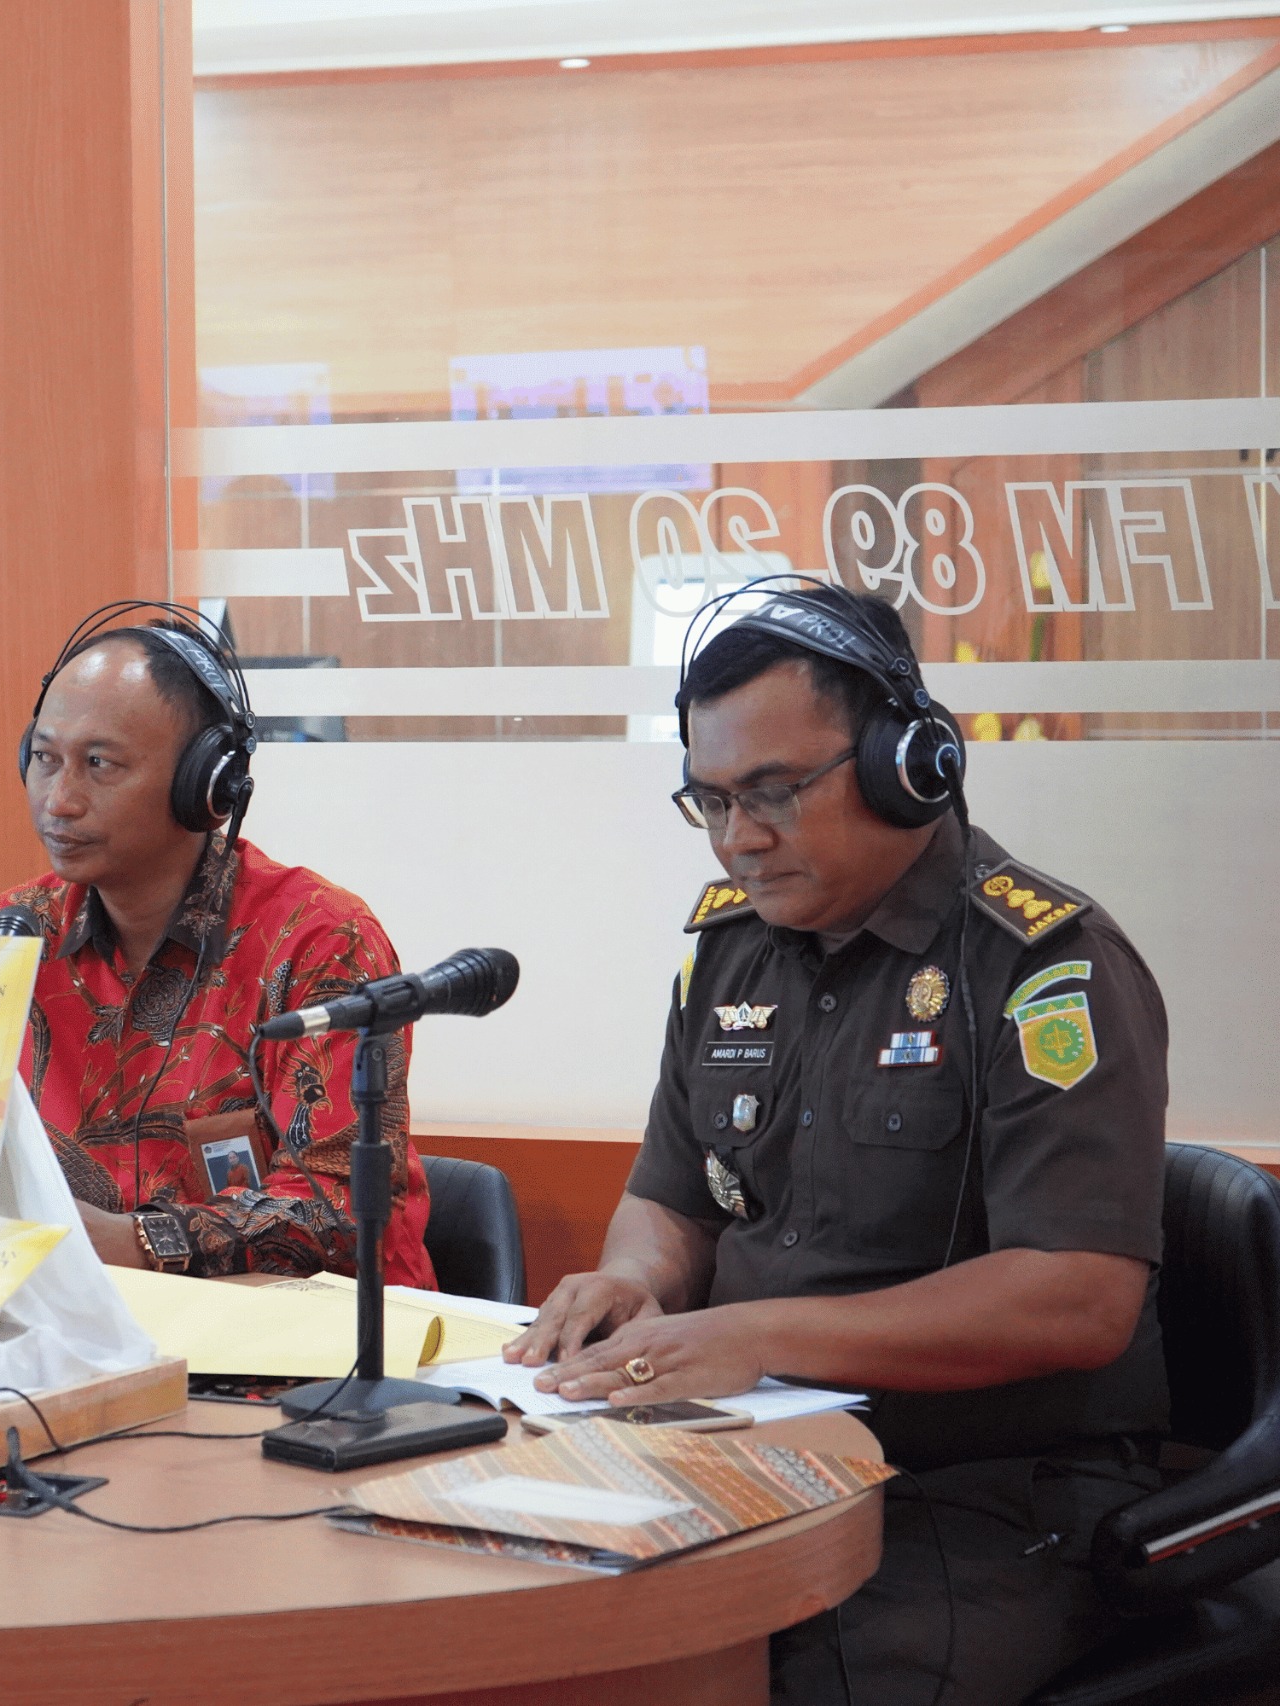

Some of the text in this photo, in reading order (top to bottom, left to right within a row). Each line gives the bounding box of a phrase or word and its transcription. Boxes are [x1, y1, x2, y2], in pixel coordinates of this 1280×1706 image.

[1027, 903, 1079, 936] JAKSA
[711, 1048, 736, 1059] AMARDI
[744, 1048, 766, 1058] BARUS
